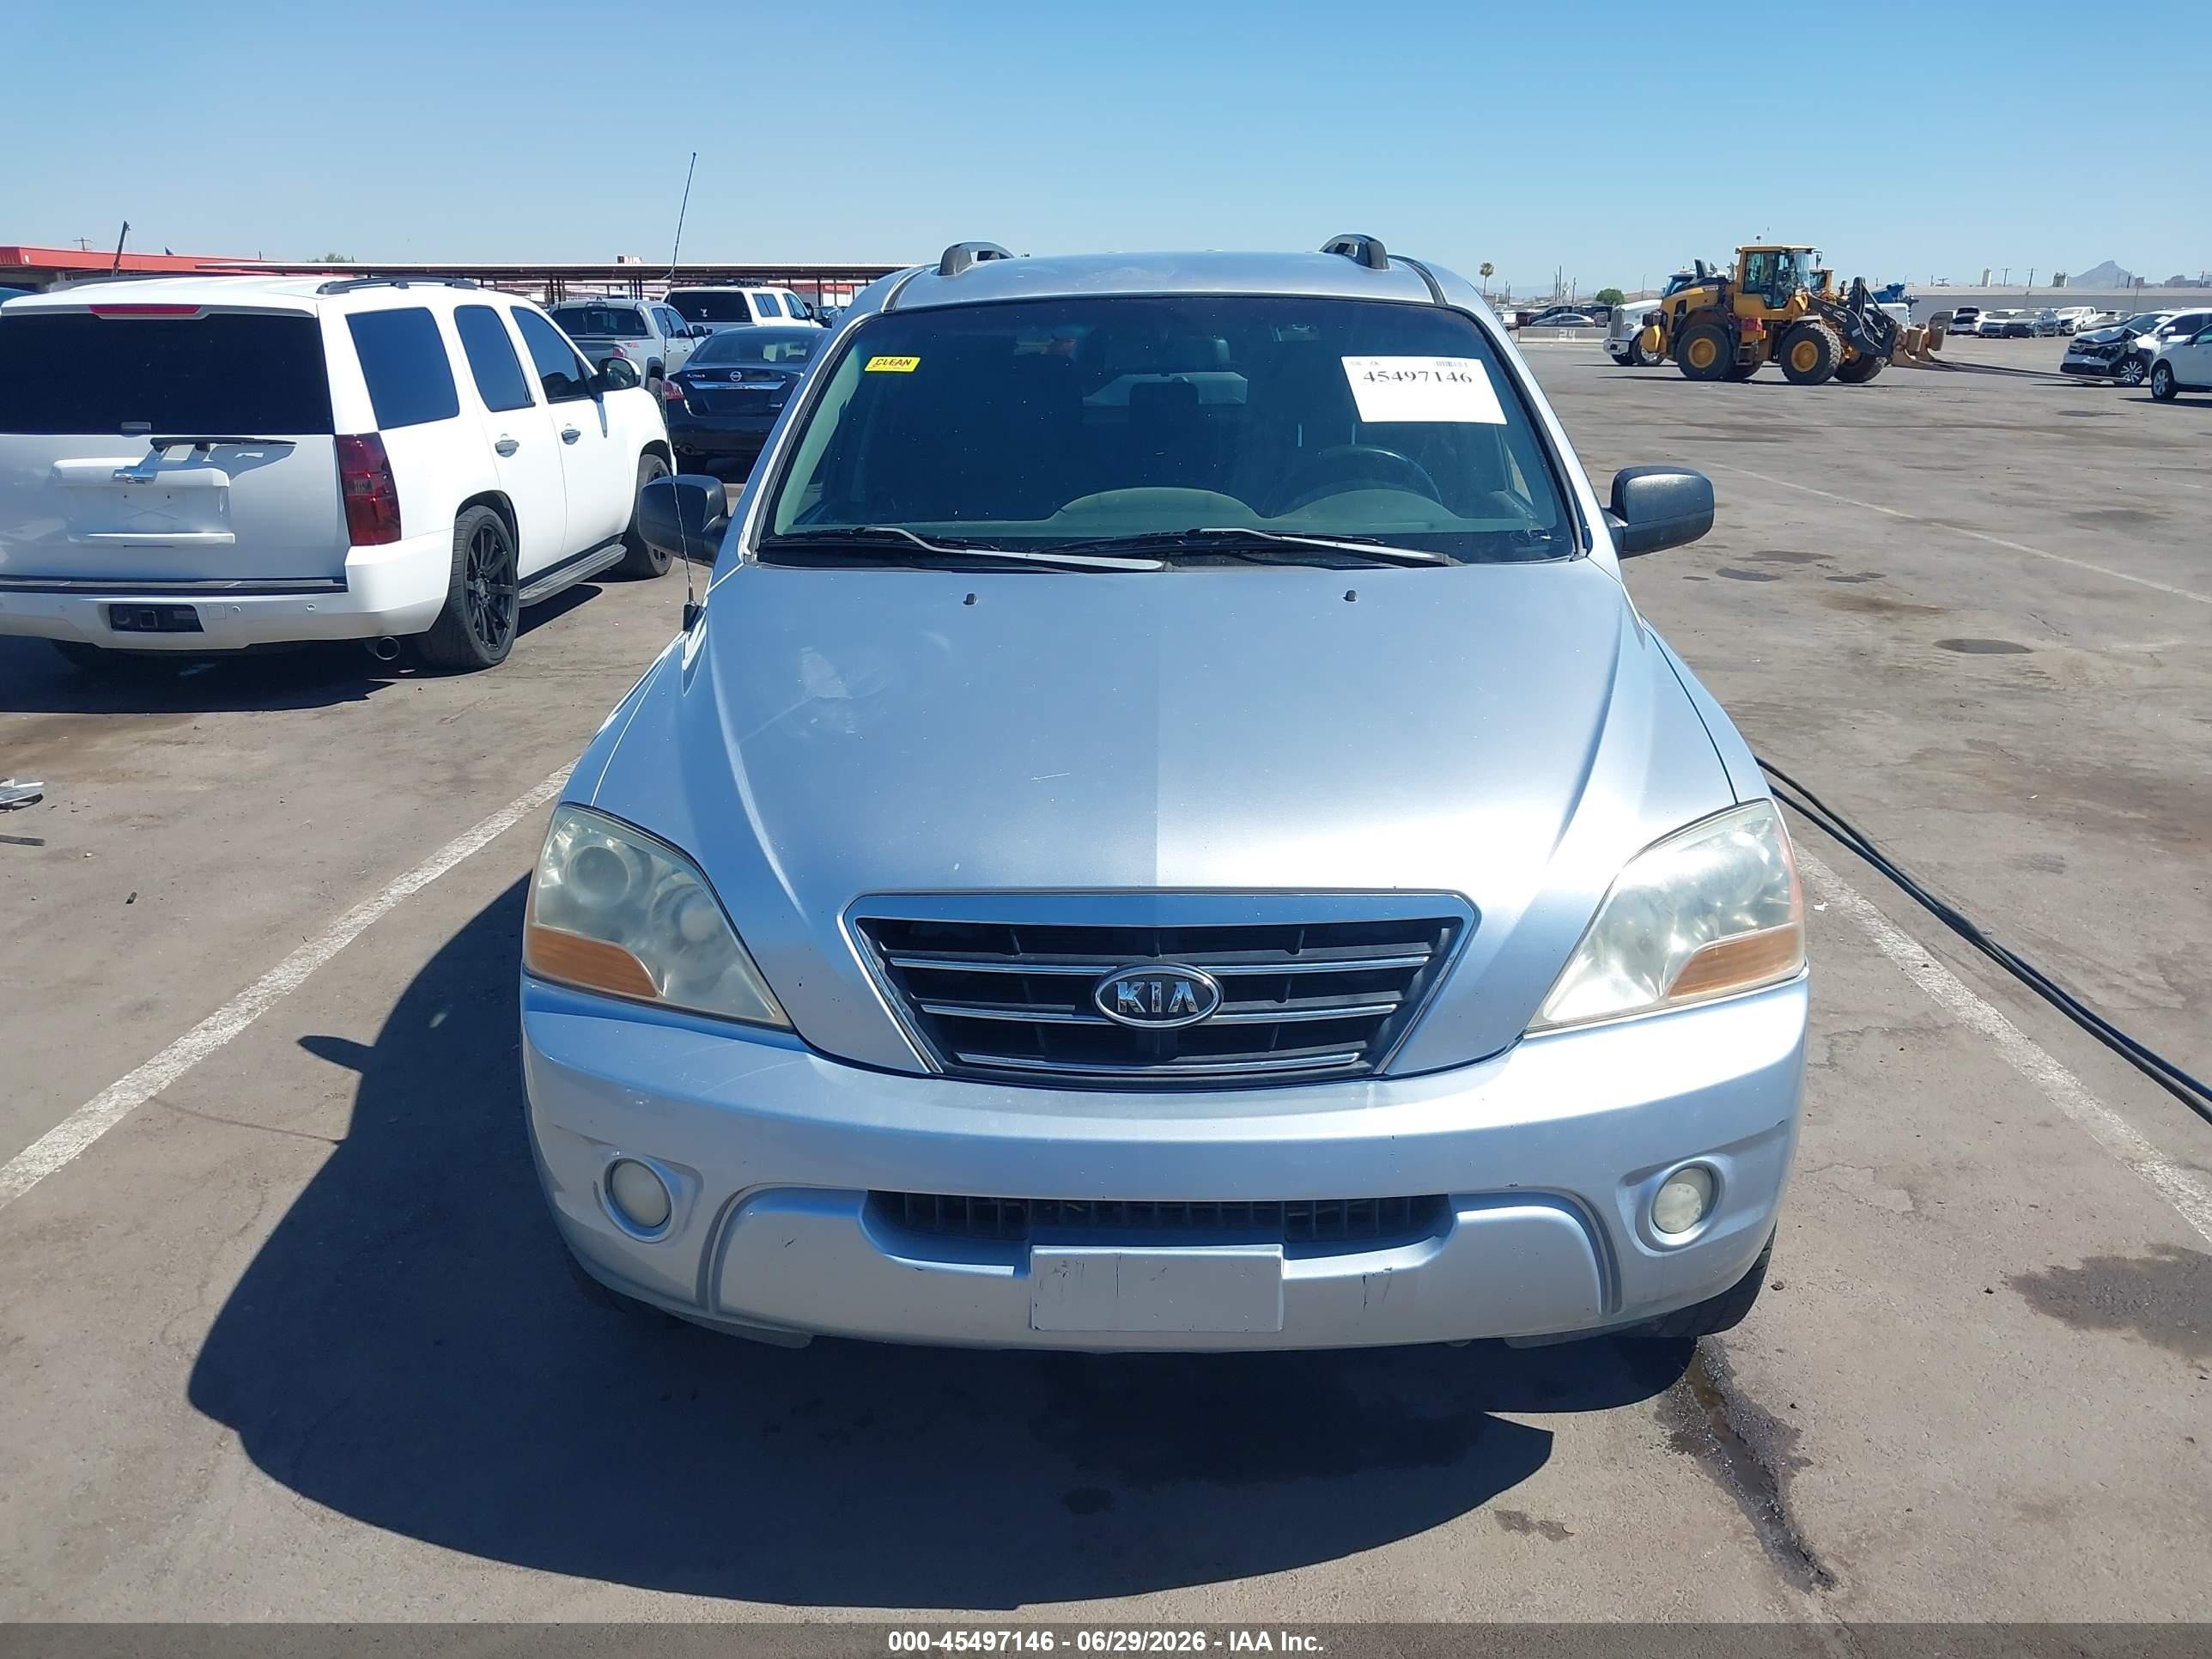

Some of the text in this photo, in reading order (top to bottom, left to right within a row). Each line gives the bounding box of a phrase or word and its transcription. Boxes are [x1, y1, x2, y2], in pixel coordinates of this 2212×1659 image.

[1559, 329, 1577, 343] 24
[1363, 371, 1473, 383] 45497146
[1115, 981, 1200, 1013] KIA
